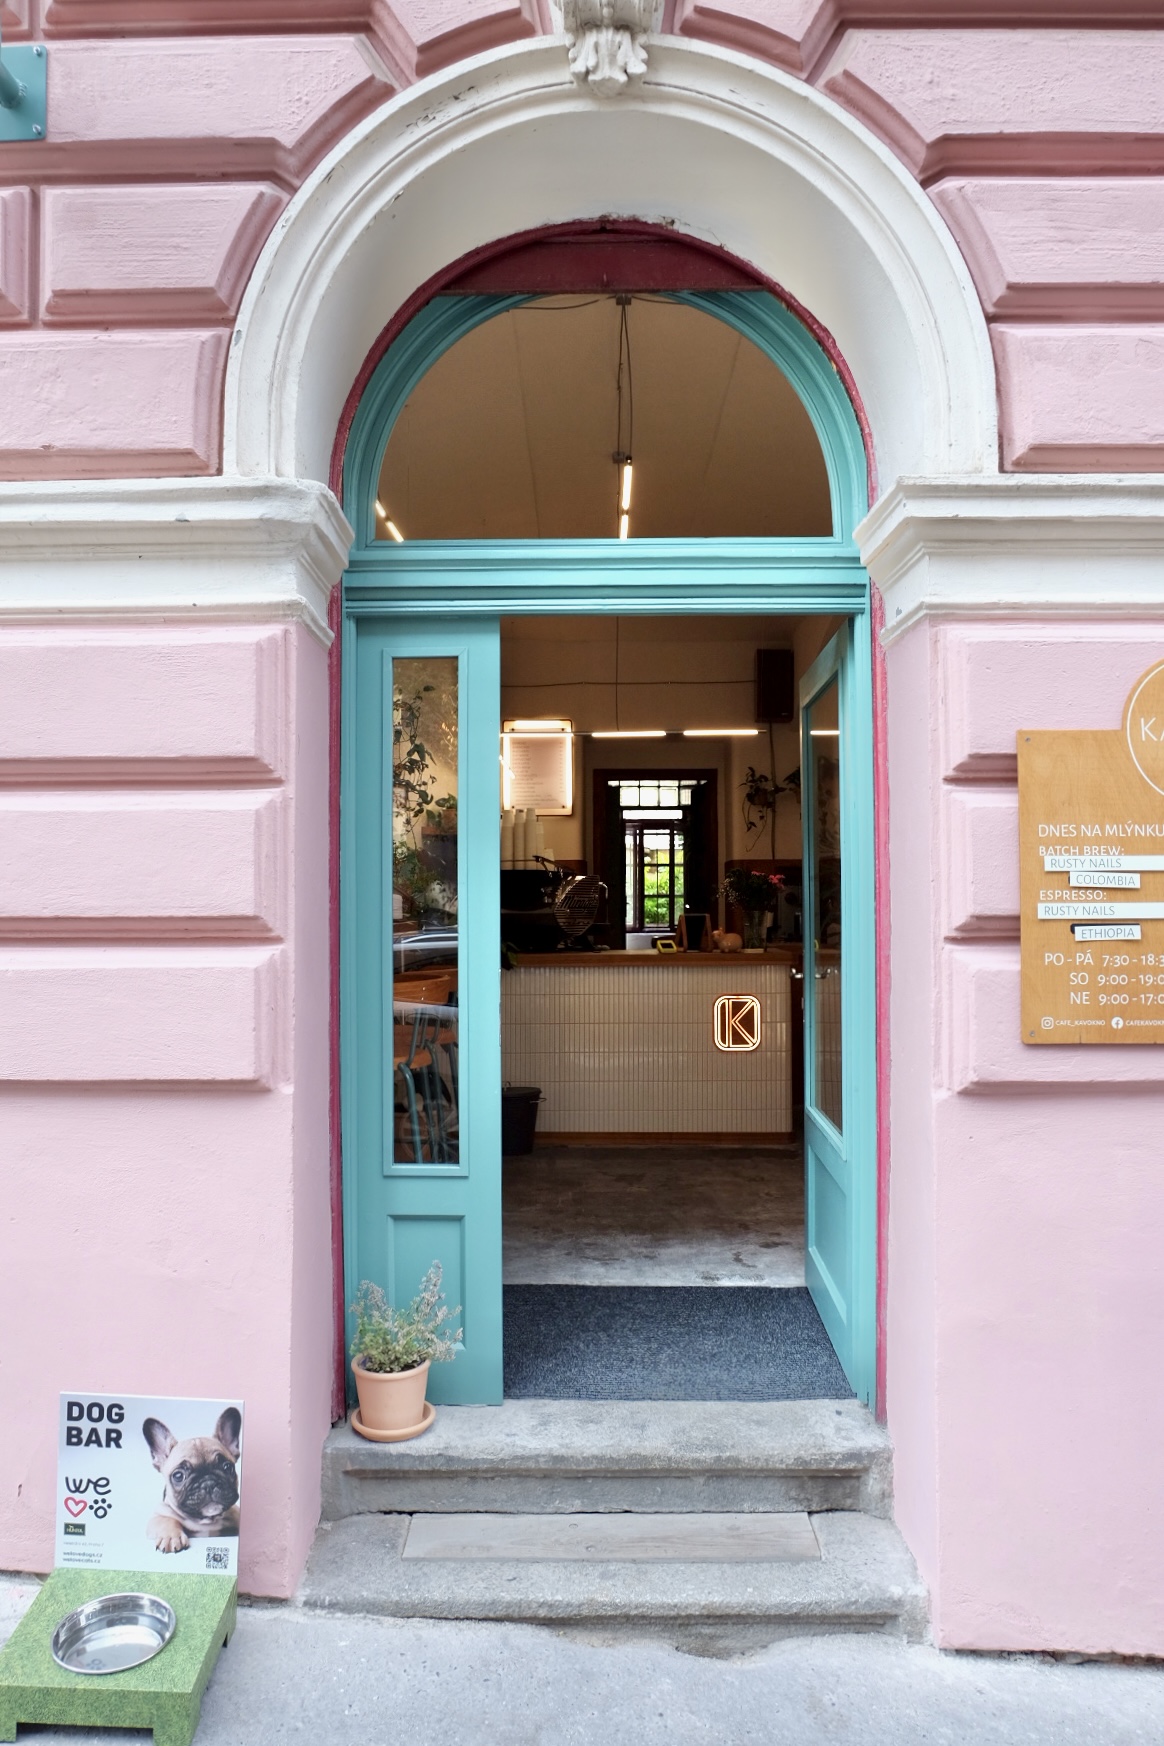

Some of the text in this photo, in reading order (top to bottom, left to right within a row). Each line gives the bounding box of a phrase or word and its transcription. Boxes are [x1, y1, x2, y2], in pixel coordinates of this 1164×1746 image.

[1038, 820, 1164, 837] DNES NA MLÝNKU
[1039, 845, 1125, 856] BATCH BREW:
[1050, 858, 1122, 868] RUSTY NAILS
[1076, 874, 1136, 886] COLOMBIA
[1039, 890, 1107, 900] ESPRESSO:
[1044, 905, 1115, 916] RUSTY NAILS
[1081, 928, 1135, 939] ETHIOPIA
[1044, 953, 1064, 966] PO
[1076, 950, 1094, 966] PÁ
[1102, 955, 1130, 967] 7:30
[1069, 972, 1089, 985] SO
[1098, 974, 1128, 986] 9:00
[1070, 992, 1090, 1004] NE
[1098, 993, 1129, 1005] 9:00
[66, 1401, 125, 1424] DOG
[66, 1426, 123, 1449] BAR
[65, 1476, 112, 1495] we
